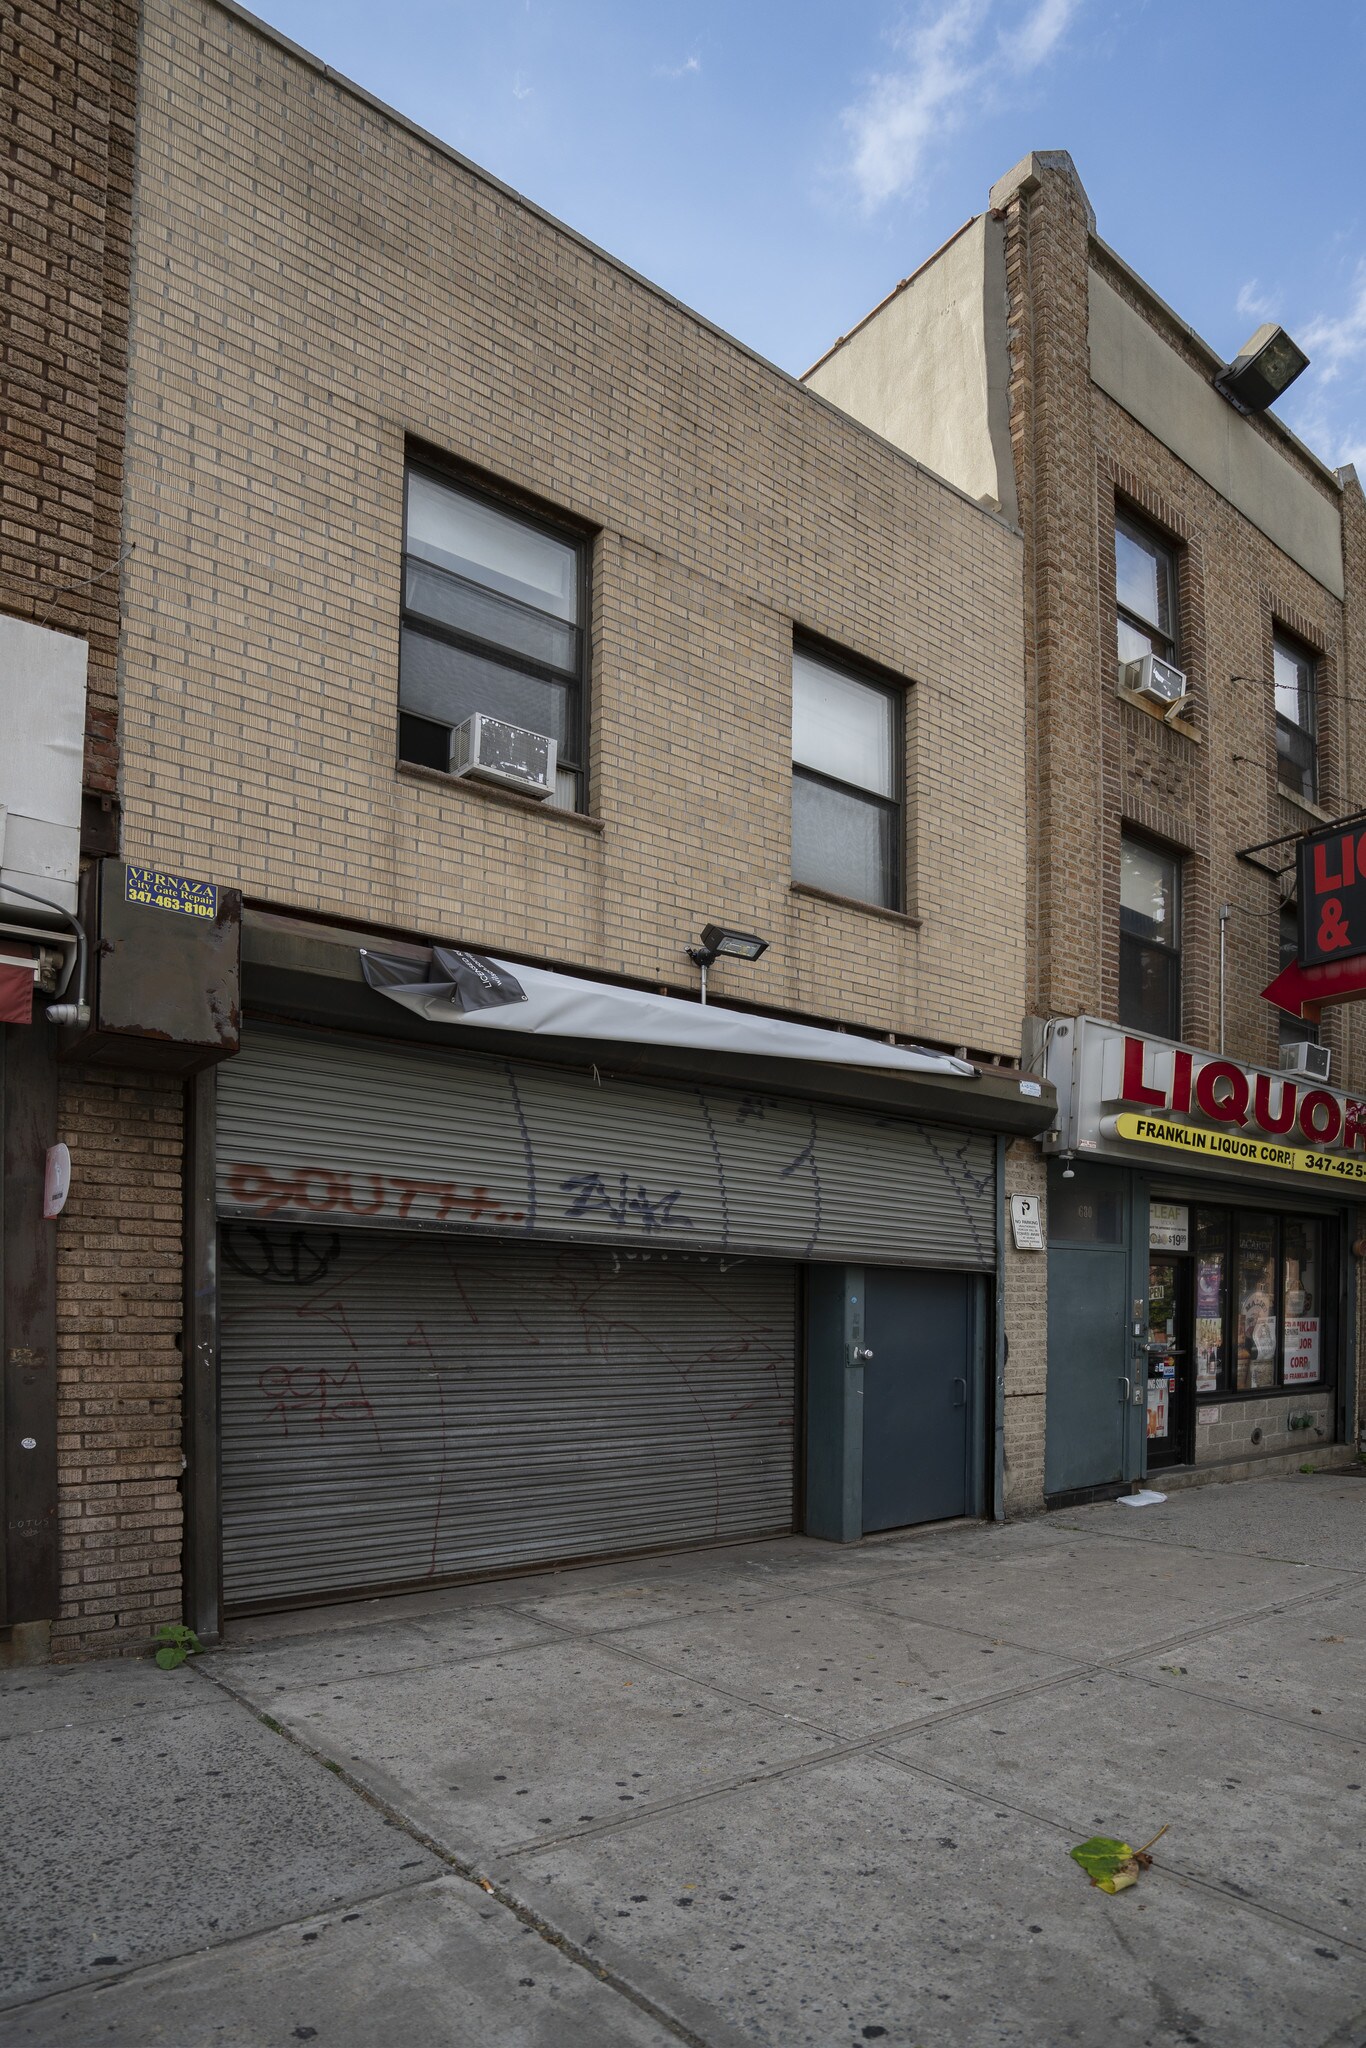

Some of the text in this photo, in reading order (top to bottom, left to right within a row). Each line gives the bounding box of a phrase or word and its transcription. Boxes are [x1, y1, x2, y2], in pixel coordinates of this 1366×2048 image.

[128, 878, 214, 905] City Gate Repair
[130, 867, 214, 897] VERNAZA
[128, 888, 214, 918] 347-463-8104
[1317, 897, 1351, 952] &
[461, 957, 492, 989] LICENSED
[1136, 1120, 1206, 1148] FRANKLIN
[1210, 1136, 1257, 1158] LIQUOR
[1260, 1147, 1291, 1165] CORP.
